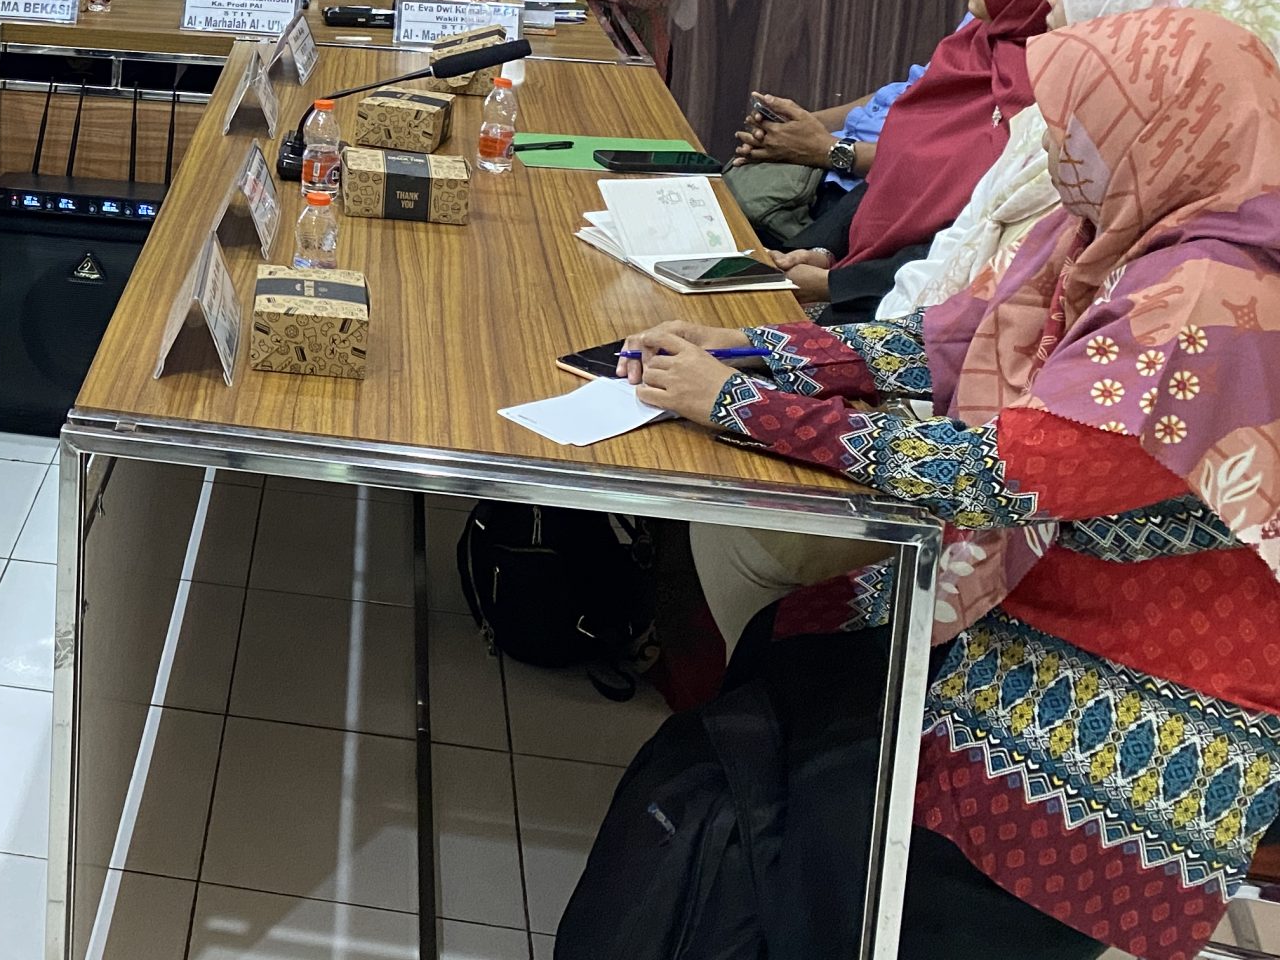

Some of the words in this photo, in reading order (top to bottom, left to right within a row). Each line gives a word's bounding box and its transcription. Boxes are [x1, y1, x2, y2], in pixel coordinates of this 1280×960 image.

[23, 2, 71, 16] BEKASI
[404, 3, 415, 12] Dr.
[418, 3, 434, 12] Eva
[436, 4, 452, 13] Dwi
[204, 16, 247, 29] Marhalah
[396, 190, 419, 200] THANK
[401, 200, 414, 209] YOU
